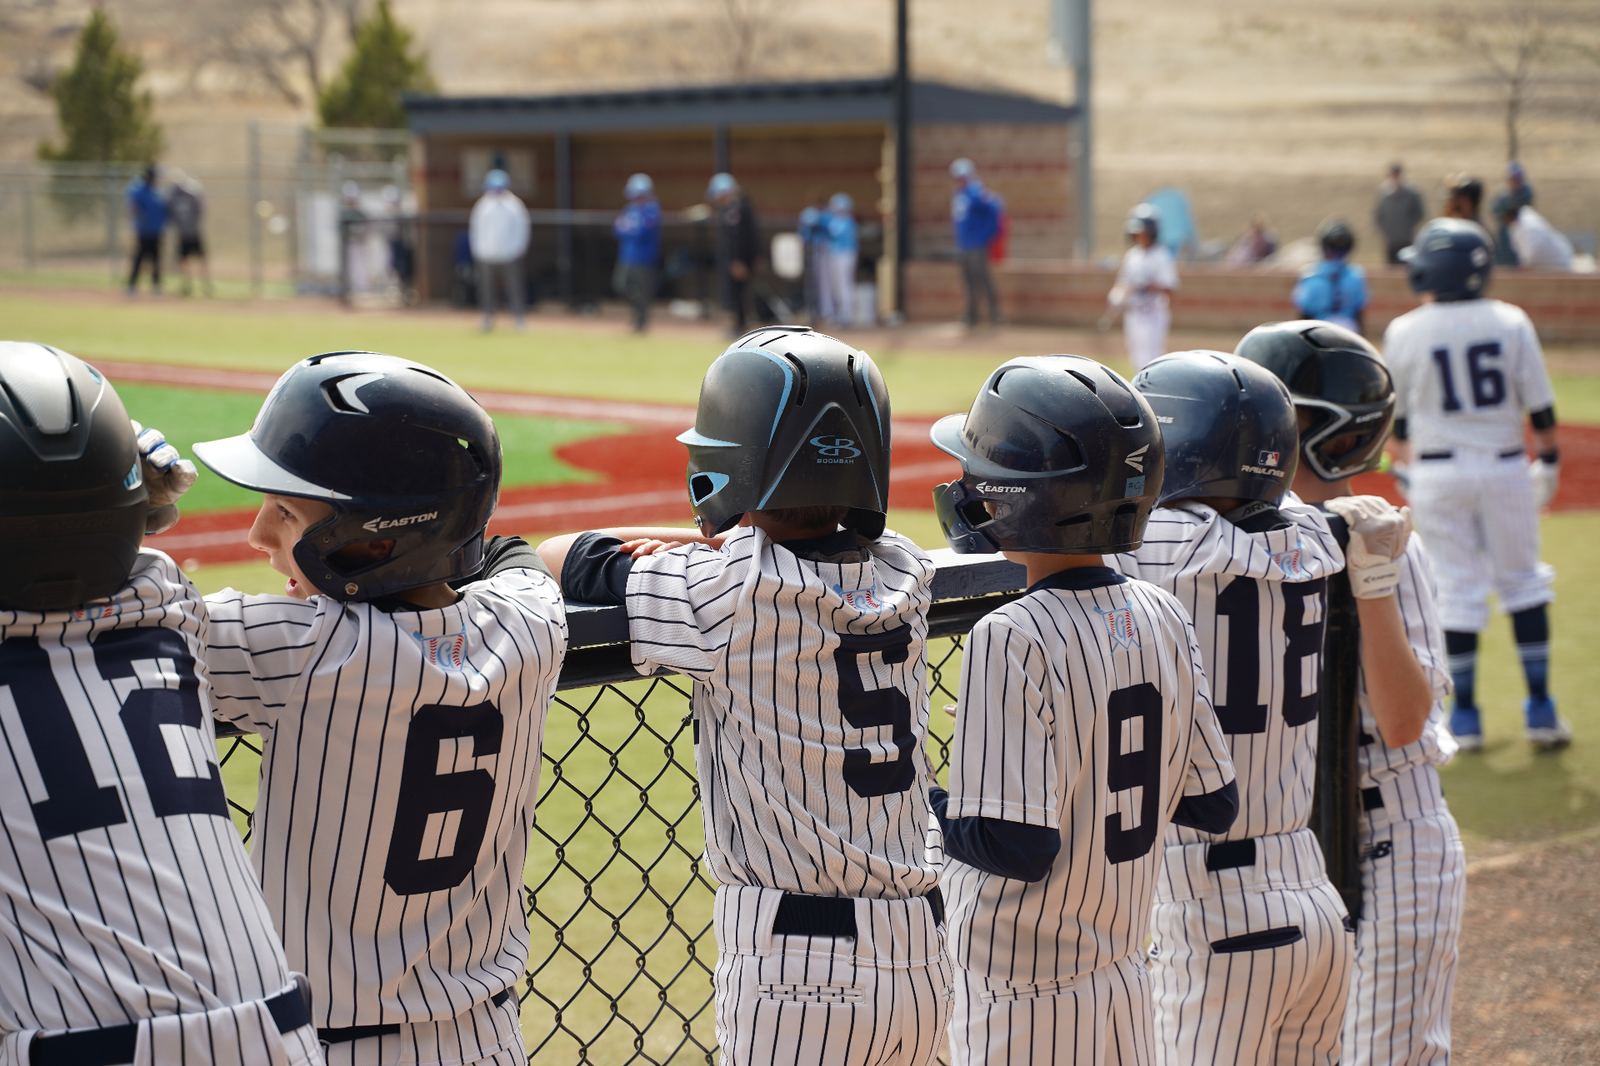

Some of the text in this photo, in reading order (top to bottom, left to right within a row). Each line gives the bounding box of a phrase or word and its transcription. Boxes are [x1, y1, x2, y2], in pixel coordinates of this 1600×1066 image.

[1432, 342, 1506, 412] 16
[379, 511, 438, 529] EASTON
[984, 485, 1027, 493] EASTON
[0, 627, 230, 841] 12
[833, 623, 917, 798] 5
[1213, 575, 1328, 735] 18
[384, 700, 503, 896] 6
[1105, 682, 1163, 864] 9
